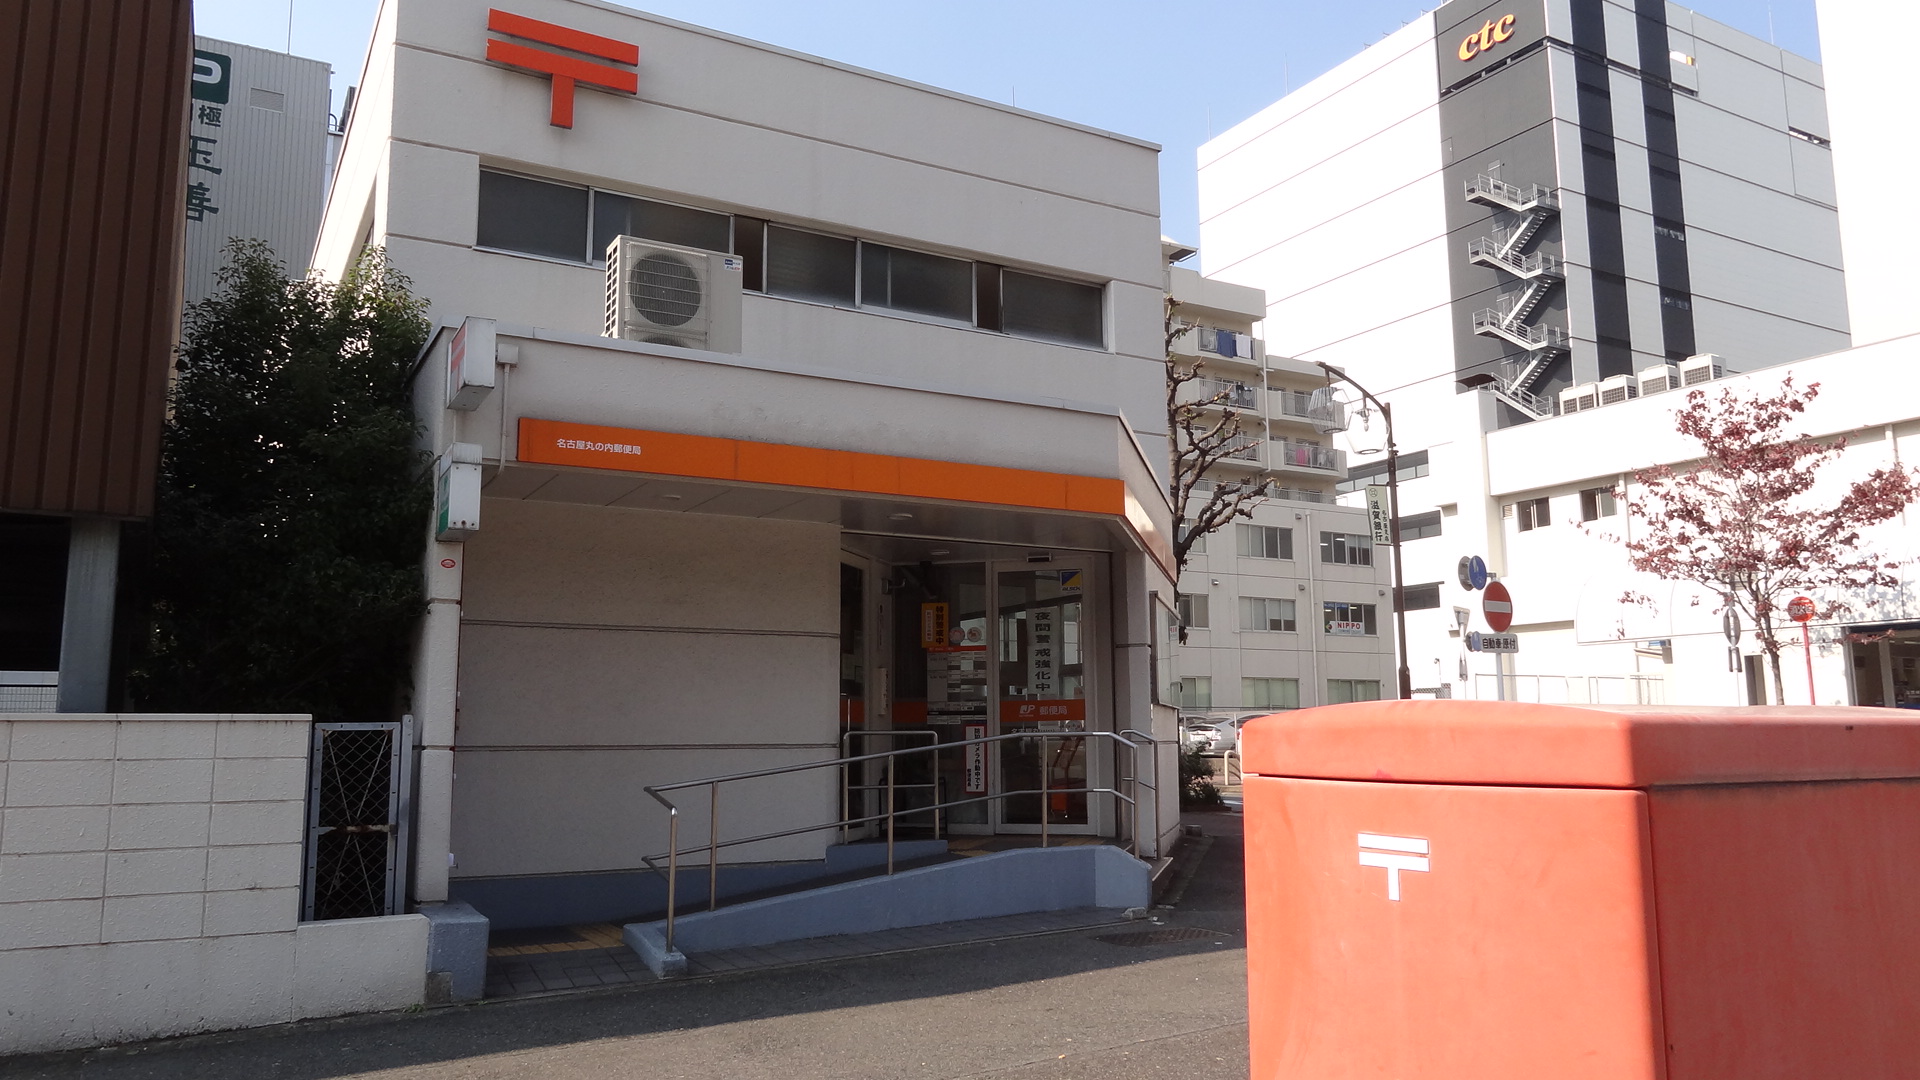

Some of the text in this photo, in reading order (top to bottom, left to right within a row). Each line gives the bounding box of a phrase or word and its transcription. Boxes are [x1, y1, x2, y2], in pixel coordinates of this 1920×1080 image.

[1459, 14, 1516, 61] ctc
[191, 103, 222, 128] 極
[557, 438, 641, 455] 名古屋丸の内郵便局
[1370, 500, 1383, 542] 滋賀銀行
[1337, 622, 1362, 630] NIPPO
[1035, 612, 1051, 692] 夜間警戒強化中
[1039, 706, 1067, 715] 郵便局
